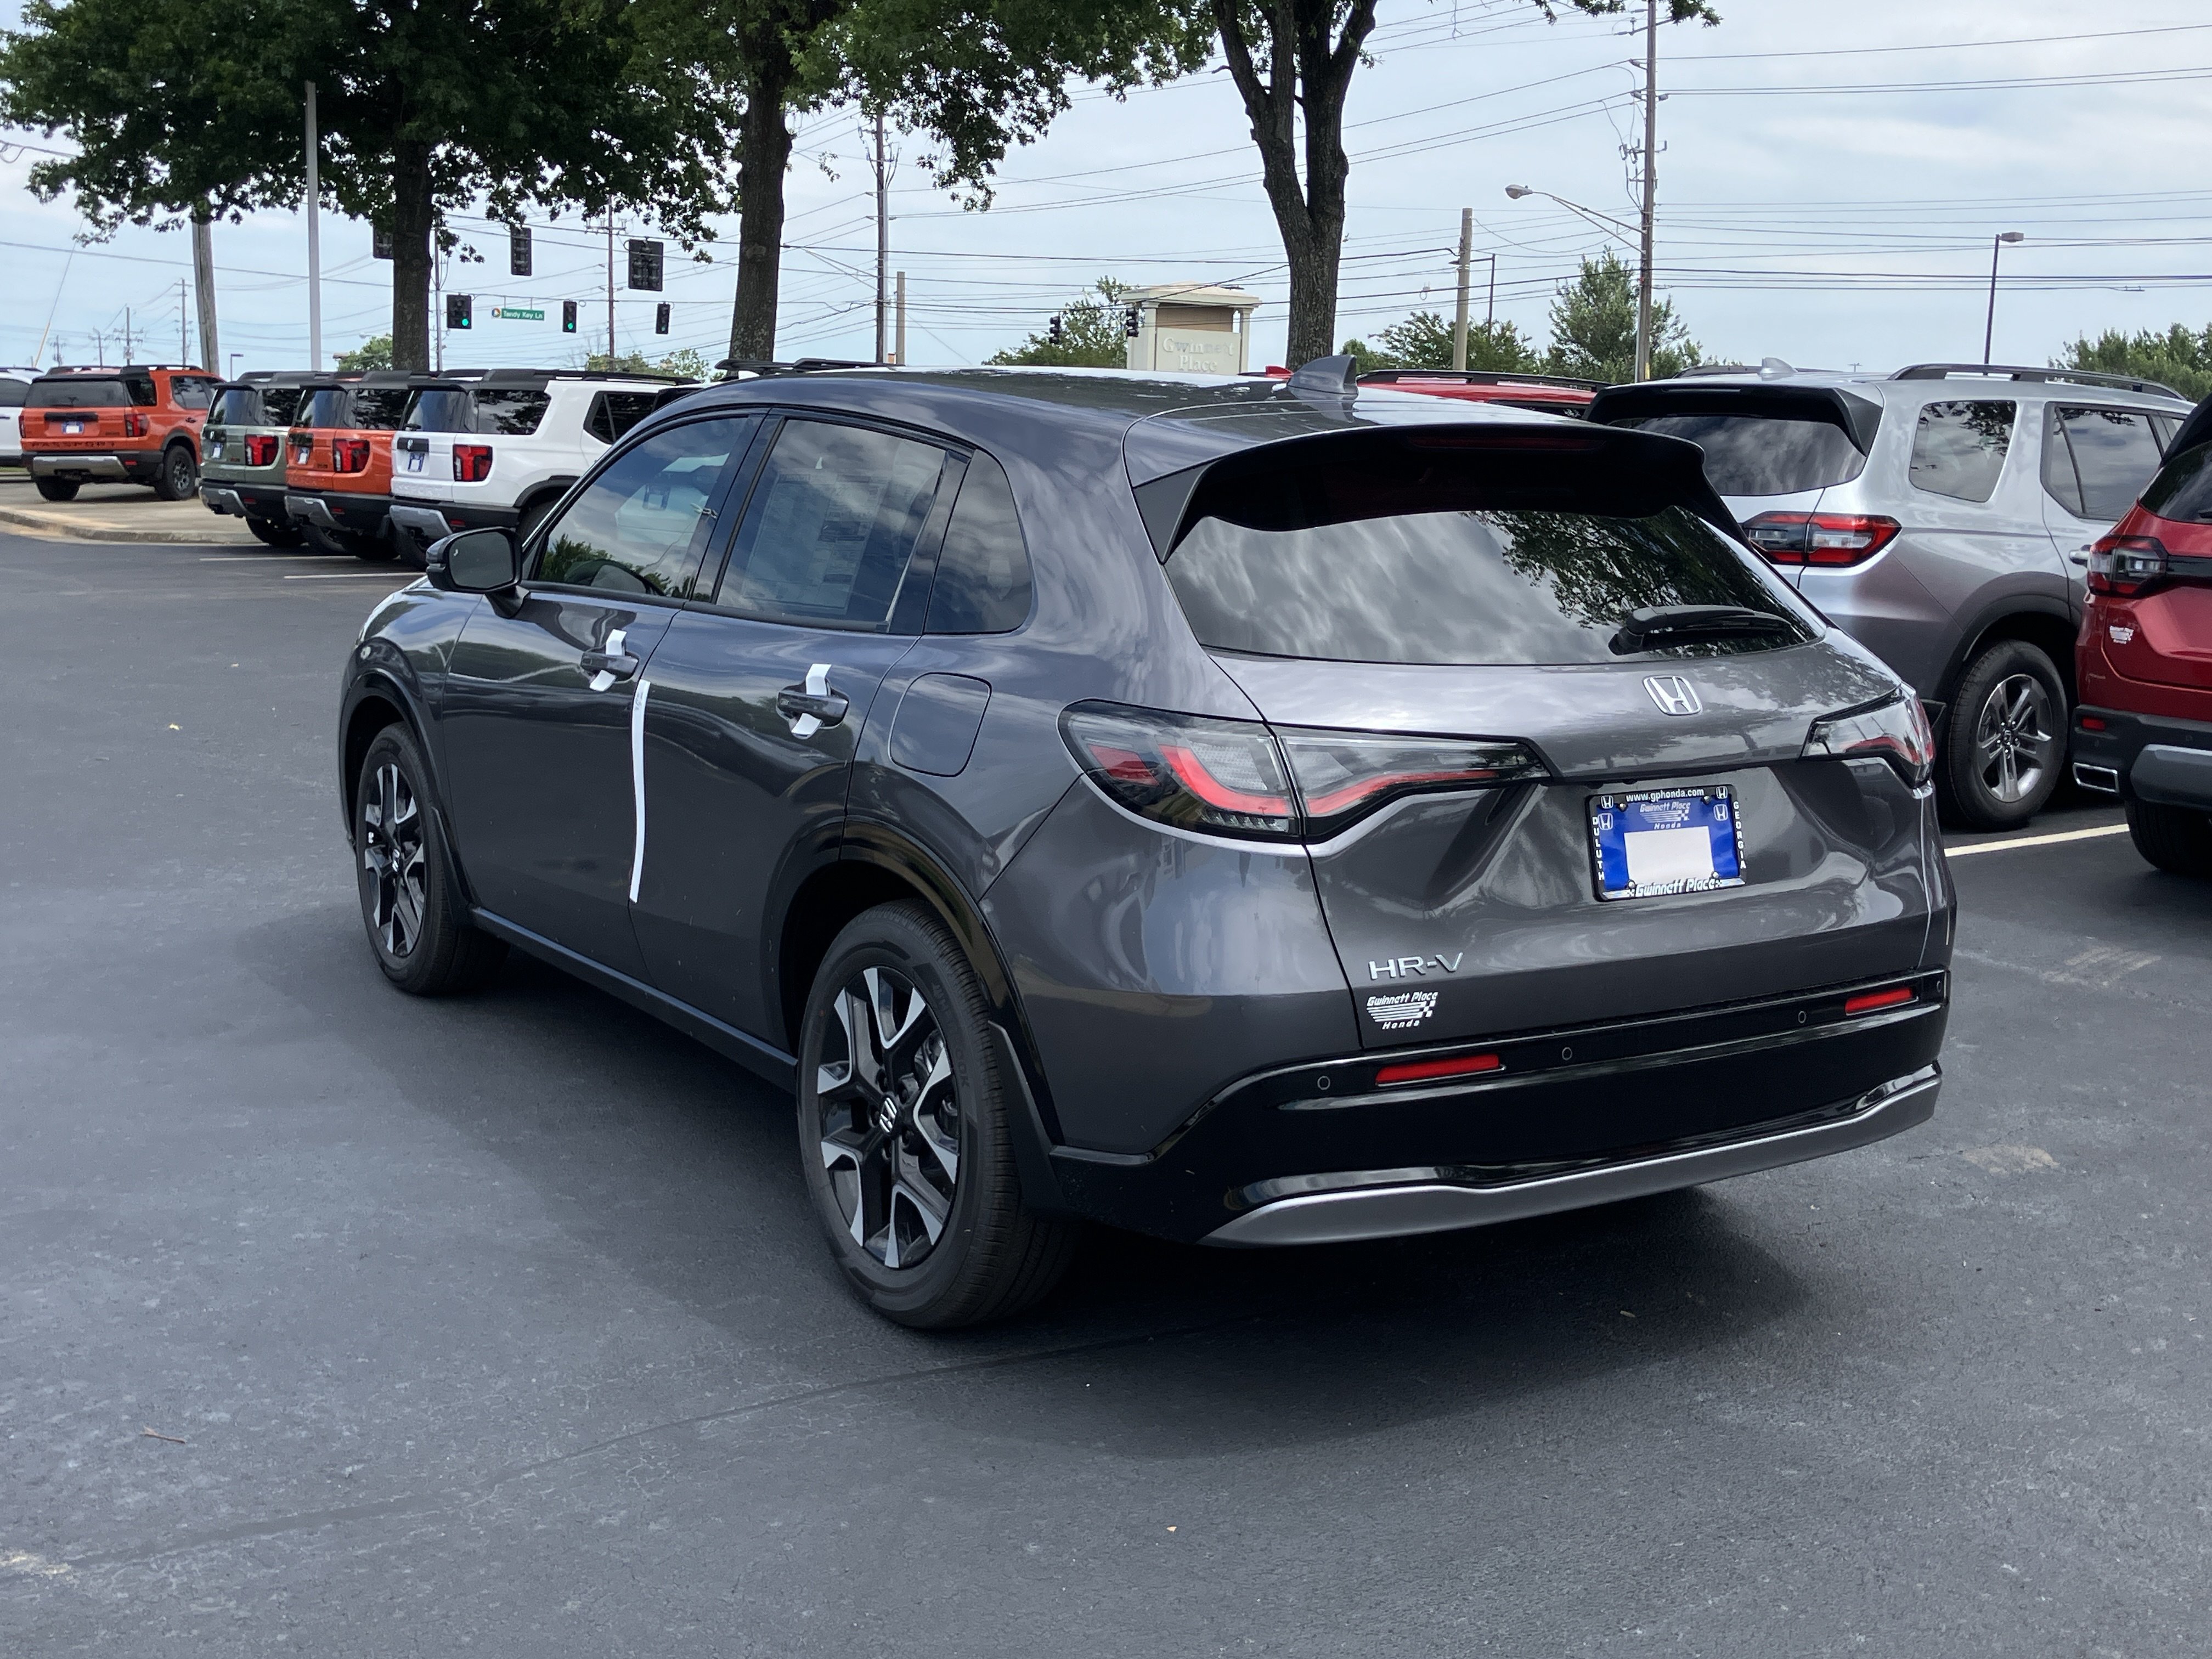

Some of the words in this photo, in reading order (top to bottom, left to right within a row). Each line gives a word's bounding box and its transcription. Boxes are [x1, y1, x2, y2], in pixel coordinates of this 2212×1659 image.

[1163, 337, 1234, 356] Gwinnet
[1178, 354, 1217, 372] Place
[1626, 788, 1704, 802] www.gphonda.com
[1640, 802, 1671, 812] Gwinnett
[1671, 801, 1691, 810] Place
[1654, 822, 1681, 830] Honda
[1733, 801, 1747, 869] GEORGIA
[1592, 816, 1605, 881] DULUTH
[1635, 879, 1684, 897] Gwinnett
[1685, 877, 1716, 892] Place
[1368, 952, 1464, 980] HR-V
[1367, 992, 1410, 1007] Gwinnett
[1411, 991, 1438, 1002] Place
[1382, 1019, 1420, 1030] Honda
